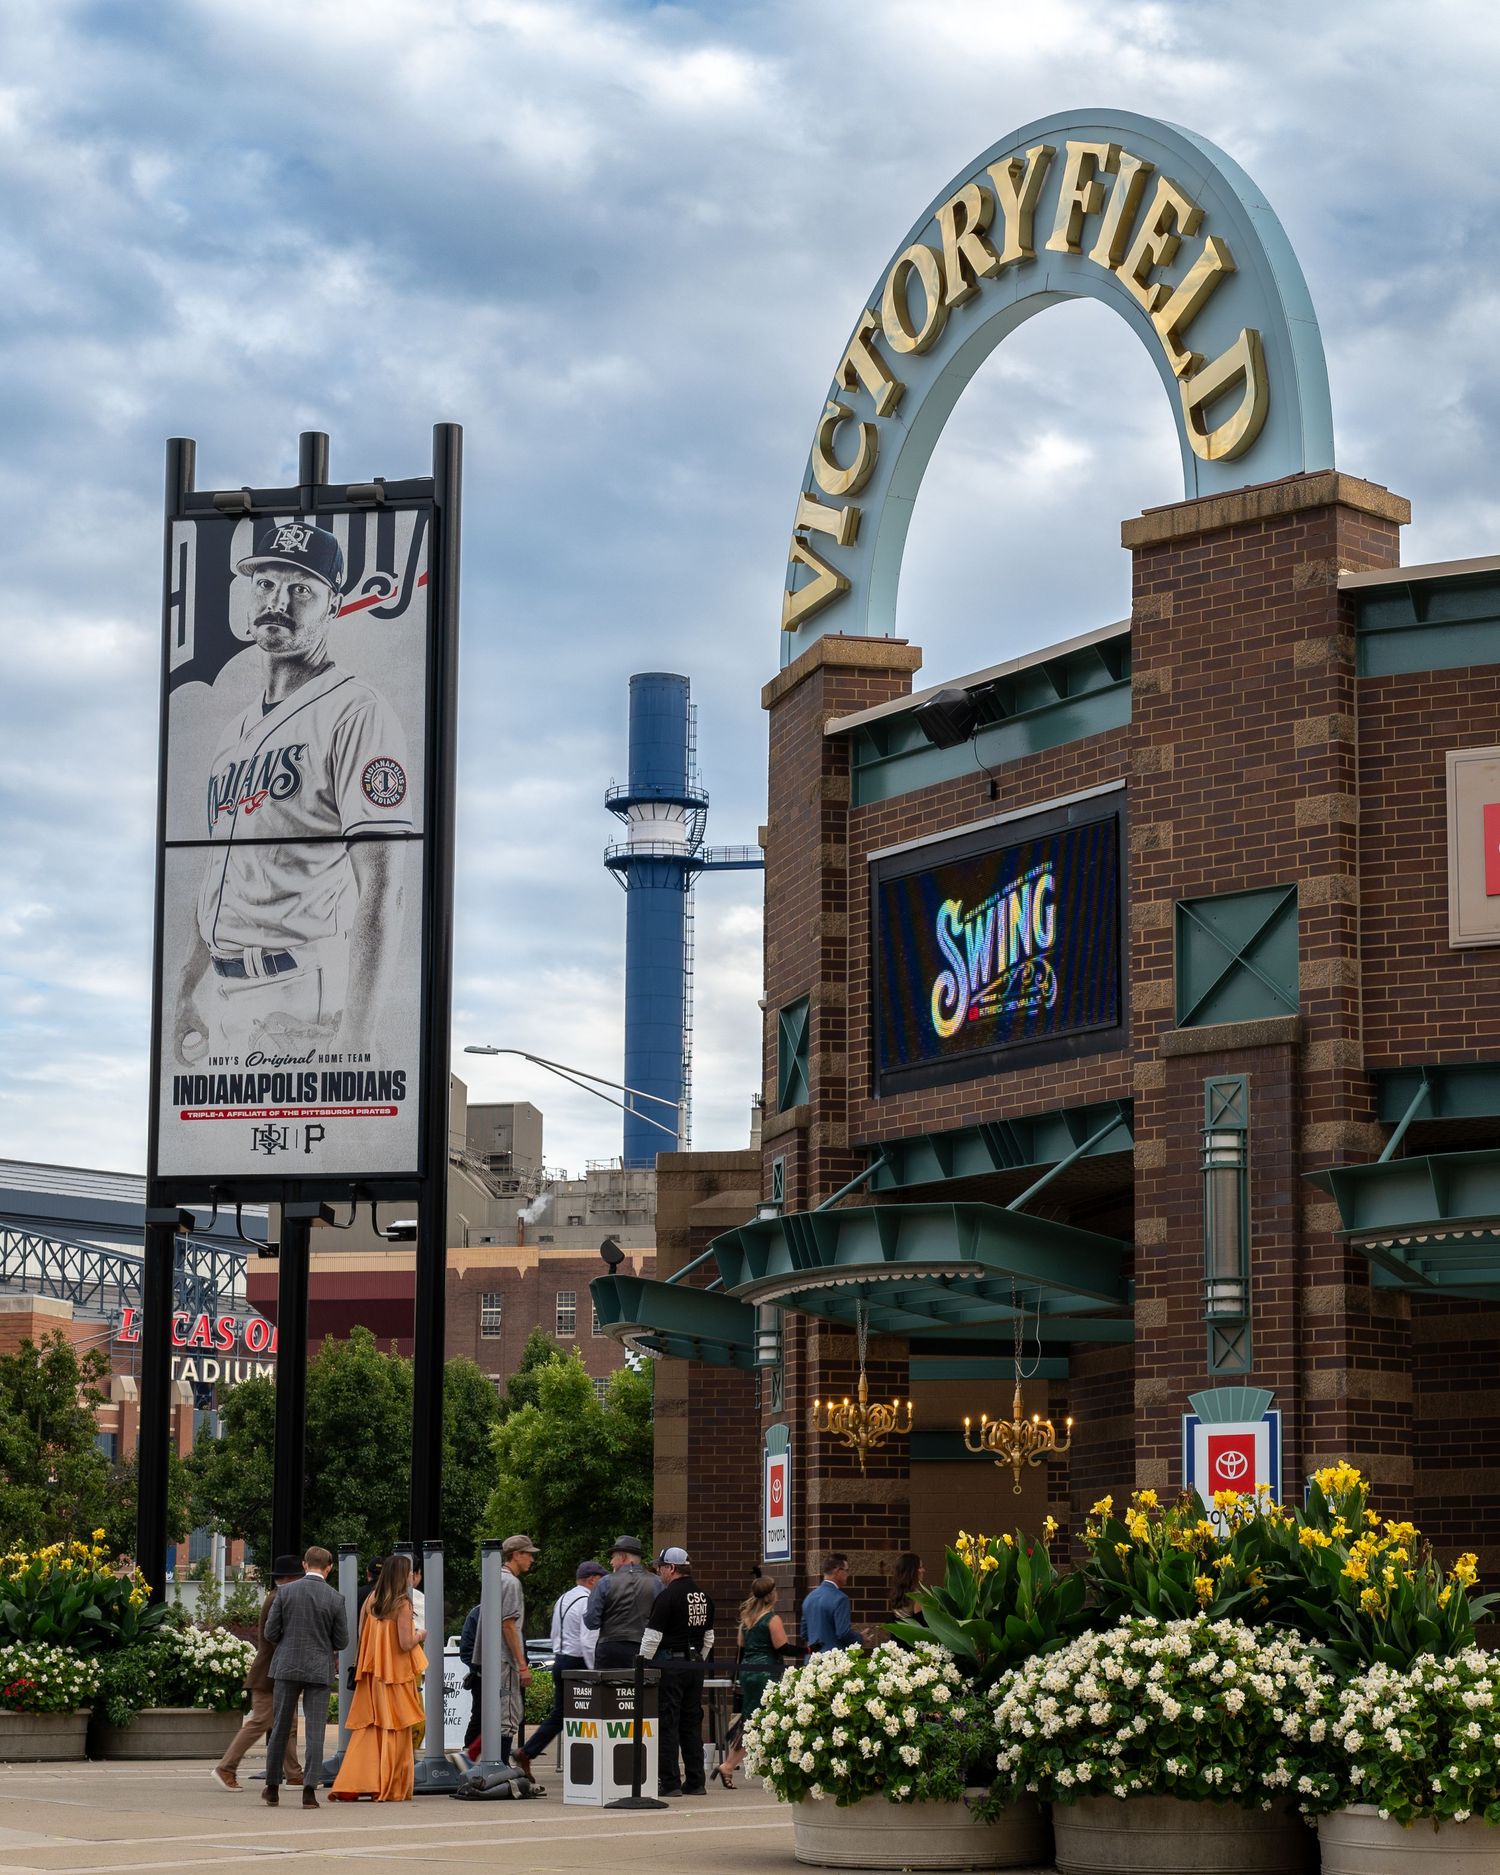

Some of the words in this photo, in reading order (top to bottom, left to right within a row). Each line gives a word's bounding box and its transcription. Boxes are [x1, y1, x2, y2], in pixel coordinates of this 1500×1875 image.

[781, 143, 1057, 633] VICTORY
[1045, 139, 1271, 463] FIELD
[208, 1056, 239, 1066] INDY'S
[245, 1049, 316, 1068] Original
[318, 1054, 343, 1063] HOME
[347, 1053, 371, 1063] TEAM
[173, 1072, 318, 1105] INDIANAPOLIS
[320, 1070, 407, 1102] INDIANS
[117, 1307, 235, 1351] LCAS
[171, 1356, 274, 1384] TADIUM
[768, 1529, 787, 1542] TOYOTA
[687, 1592, 707, 1603] CSC
[688, 1604, 707, 1615] EVENT
[688, 1615, 707, 1626] STAFF
[573, 1687, 593, 1696] TRASH
[574, 1701, 590, 1710] ONLY
[618, 1702, 635, 1710] ONL
[444, 1717, 462, 1726] ANCE
[565, 1721, 598, 1739] WM
